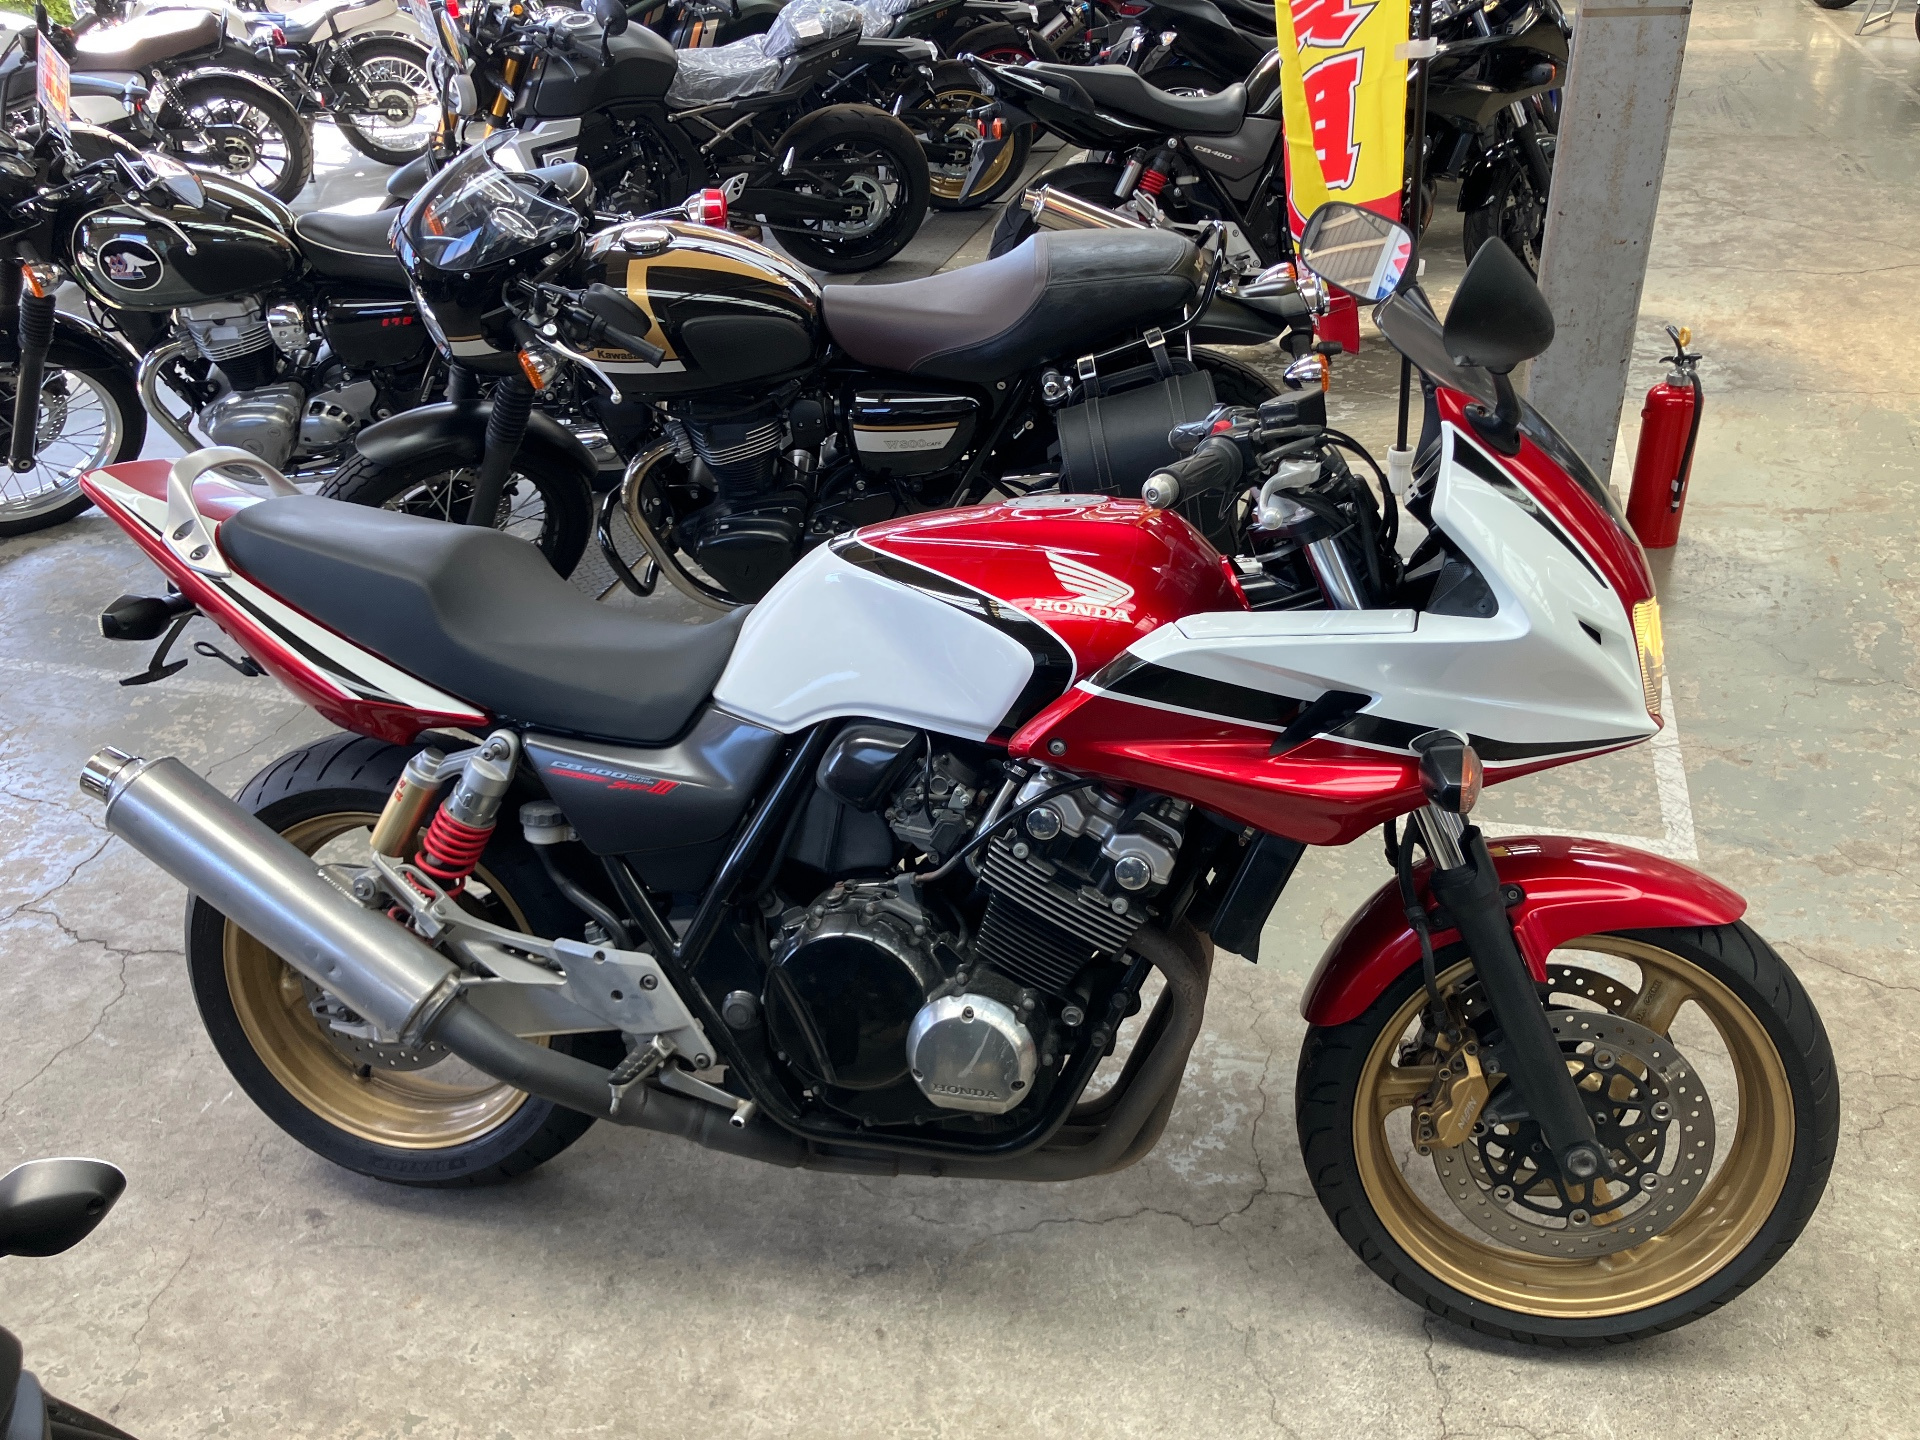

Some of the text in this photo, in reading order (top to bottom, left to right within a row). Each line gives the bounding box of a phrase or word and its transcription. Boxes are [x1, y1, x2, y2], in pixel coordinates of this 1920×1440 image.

[1193, 145, 1233, 160] CB400
[1030, 598, 1134, 624] HONDA
[549, 760, 628, 779] CB400
[932, 1083, 1000, 1099] HONDA
